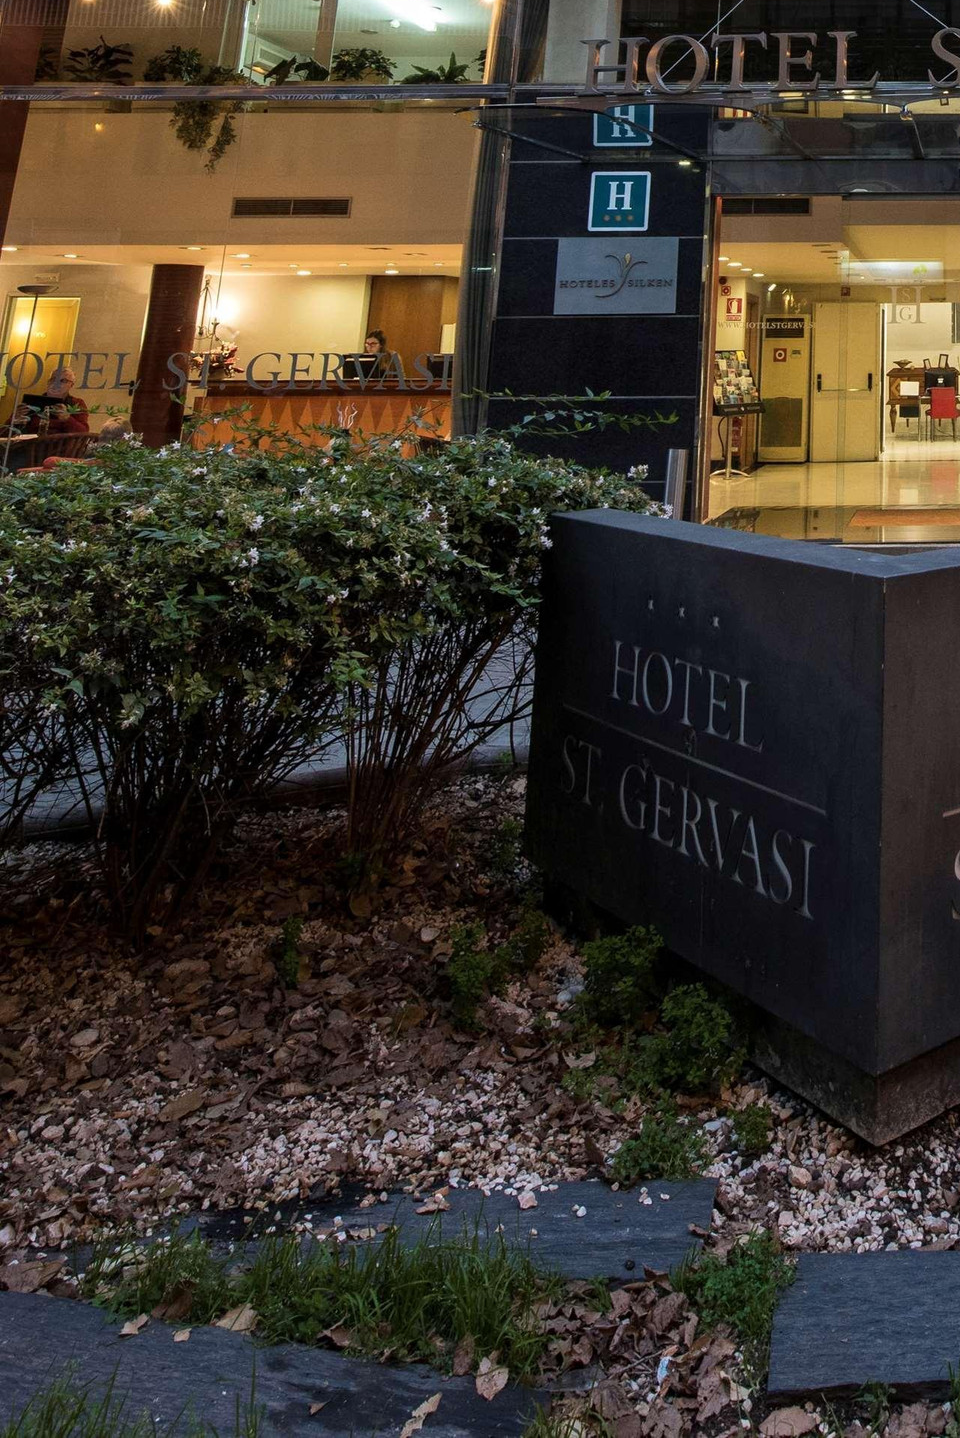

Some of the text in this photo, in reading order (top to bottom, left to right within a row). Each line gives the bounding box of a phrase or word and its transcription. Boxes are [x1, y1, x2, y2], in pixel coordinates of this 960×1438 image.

[577, 31, 880, 96] HOTEL
[606, 181, 635, 211] H
[559, 278, 673, 289] HOTELES SILKEN
[246, 351, 453, 391] GERVASI
[611, 640, 763, 753] HOTEL
[619, 762, 816, 921] GERVASI
